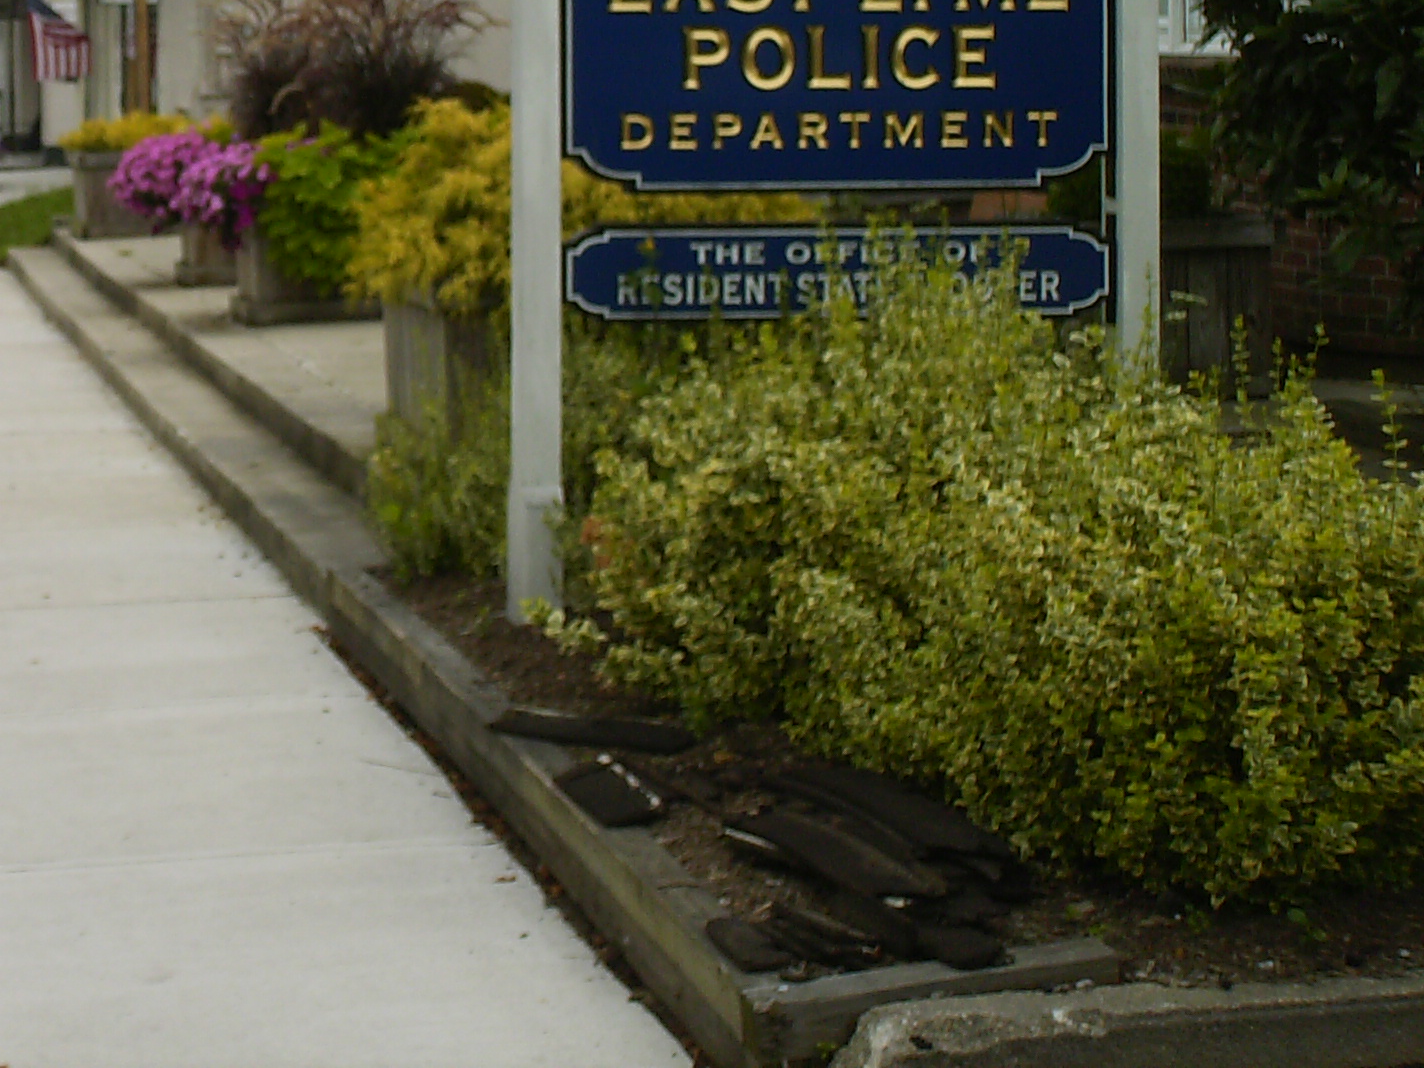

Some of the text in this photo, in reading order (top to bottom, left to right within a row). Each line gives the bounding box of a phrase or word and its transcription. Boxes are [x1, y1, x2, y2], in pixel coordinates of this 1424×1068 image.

[682, 23, 998, 91] POLICE
[621, 109, 1059, 151] DEPARTMENT
[689, 241, 766, 266] THE
[795, 270, 893, 305] STAT
